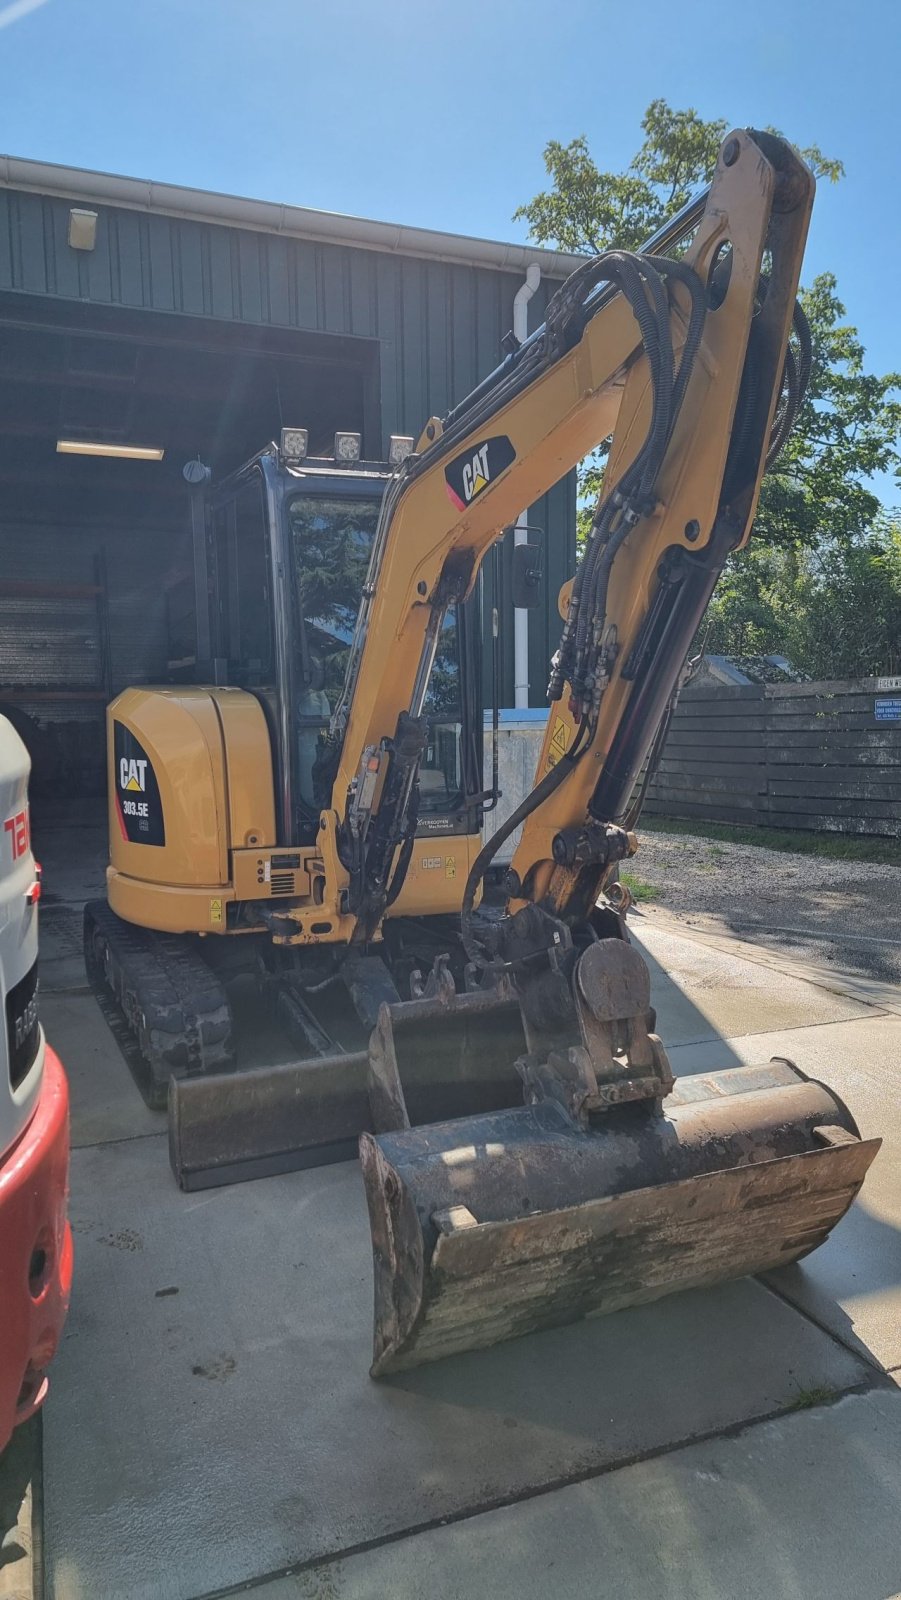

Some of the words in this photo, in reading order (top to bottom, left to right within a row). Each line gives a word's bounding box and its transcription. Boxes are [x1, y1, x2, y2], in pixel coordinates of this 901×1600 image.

[462, 443, 490, 501] CAT
[120, 757, 147, 792] CAT
[123, 800, 149, 817] 303.5E
